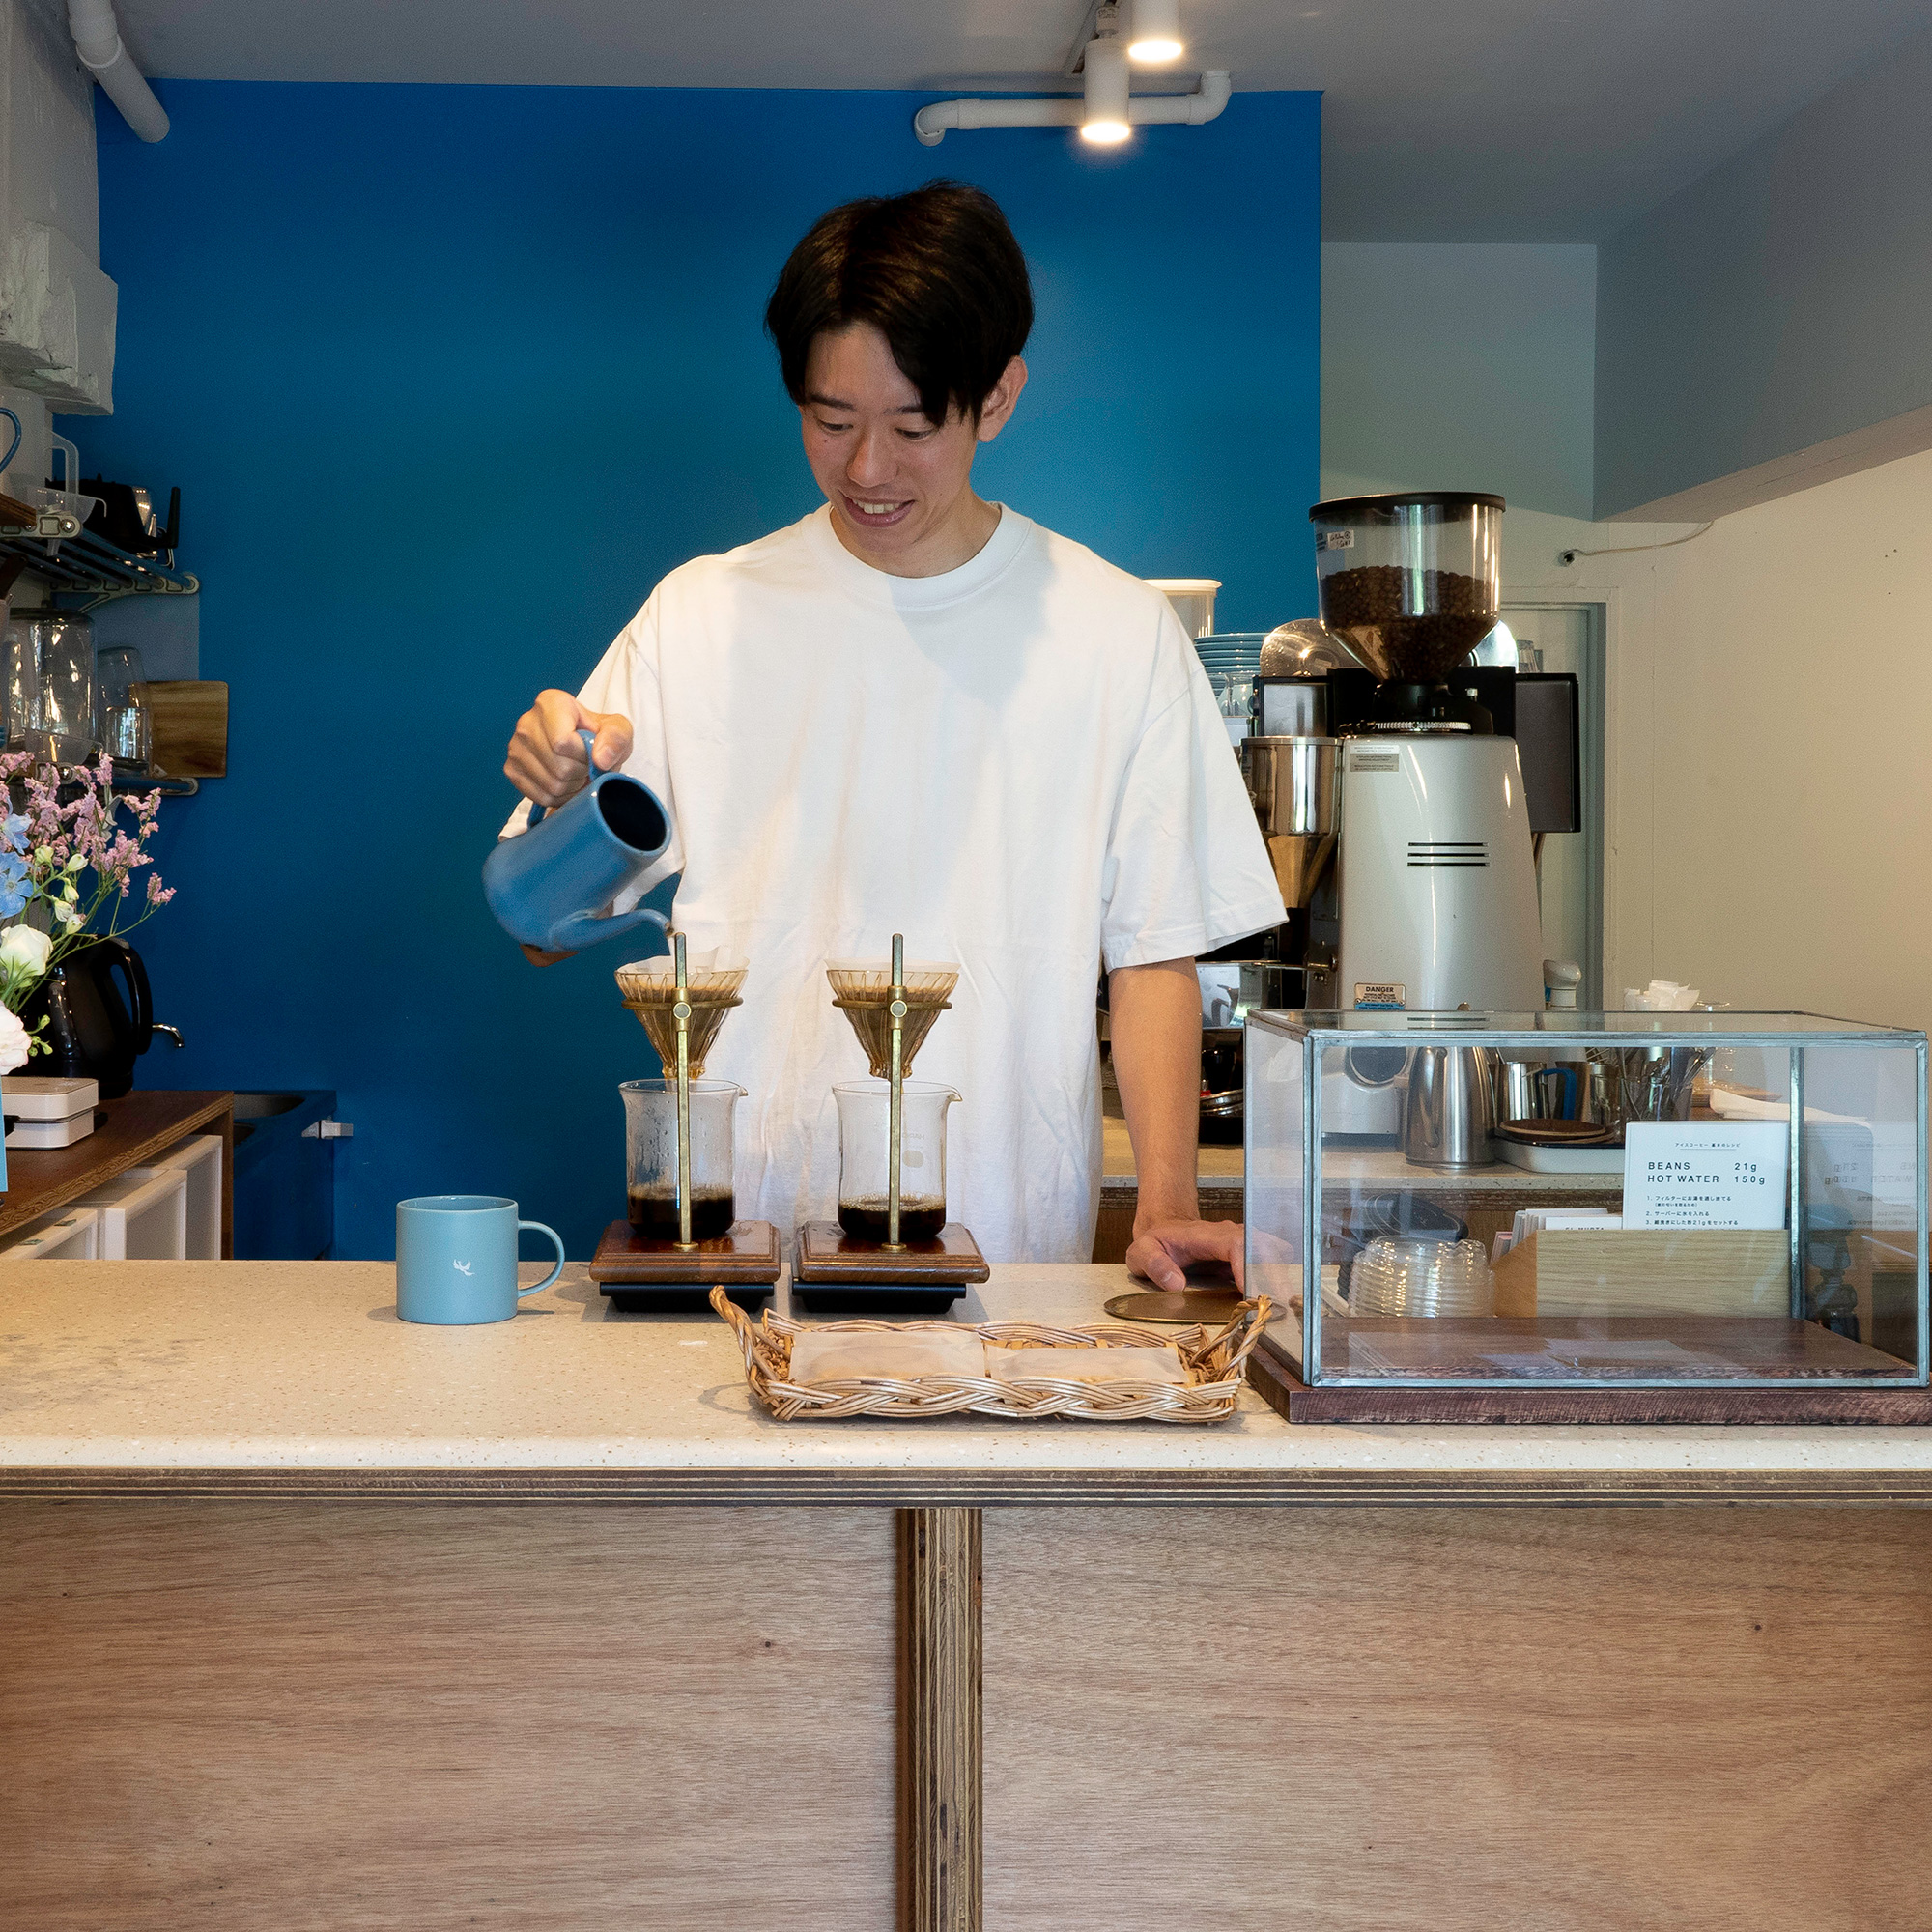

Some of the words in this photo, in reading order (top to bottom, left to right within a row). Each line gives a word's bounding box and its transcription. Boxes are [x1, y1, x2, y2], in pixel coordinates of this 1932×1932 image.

[1734, 1163, 1757, 1173] 21g
[1647, 1175, 1672, 1183] HOT
[1677, 1175, 1719, 1183] WATER
[1735, 1176, 1766, 1185] 150g
